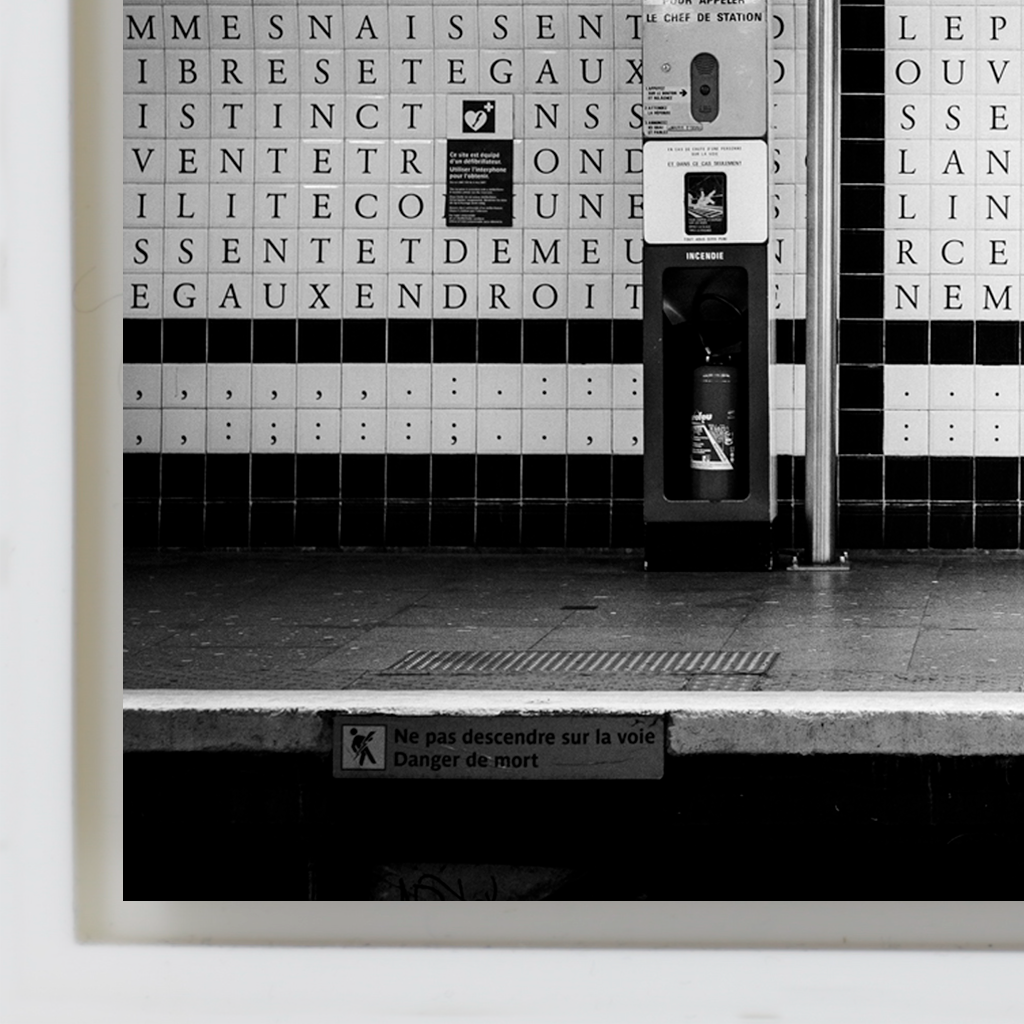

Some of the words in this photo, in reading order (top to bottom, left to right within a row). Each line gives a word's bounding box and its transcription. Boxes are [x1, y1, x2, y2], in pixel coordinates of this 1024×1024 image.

[646, 13, 657, 23] LE
[664, 12, 691, 23] CHEF
[697, 12, 711, 22] DE
[717, 12, 762, 22] STATION
[686, 251, 724, 260] INCENDIE
[394, 728, 419, 745] Ne
[425, 731, 456, 748] pas
[462, 728, 556, 745] descendre
[562, 732, 589, 745] sur
[595, 728, 612, 745] la
[617, 728, 656, 745] voie
[394, 752, 458, 771] Danger
[466, 752, 488, 768] de
[494, 753, 539, 768] mort
